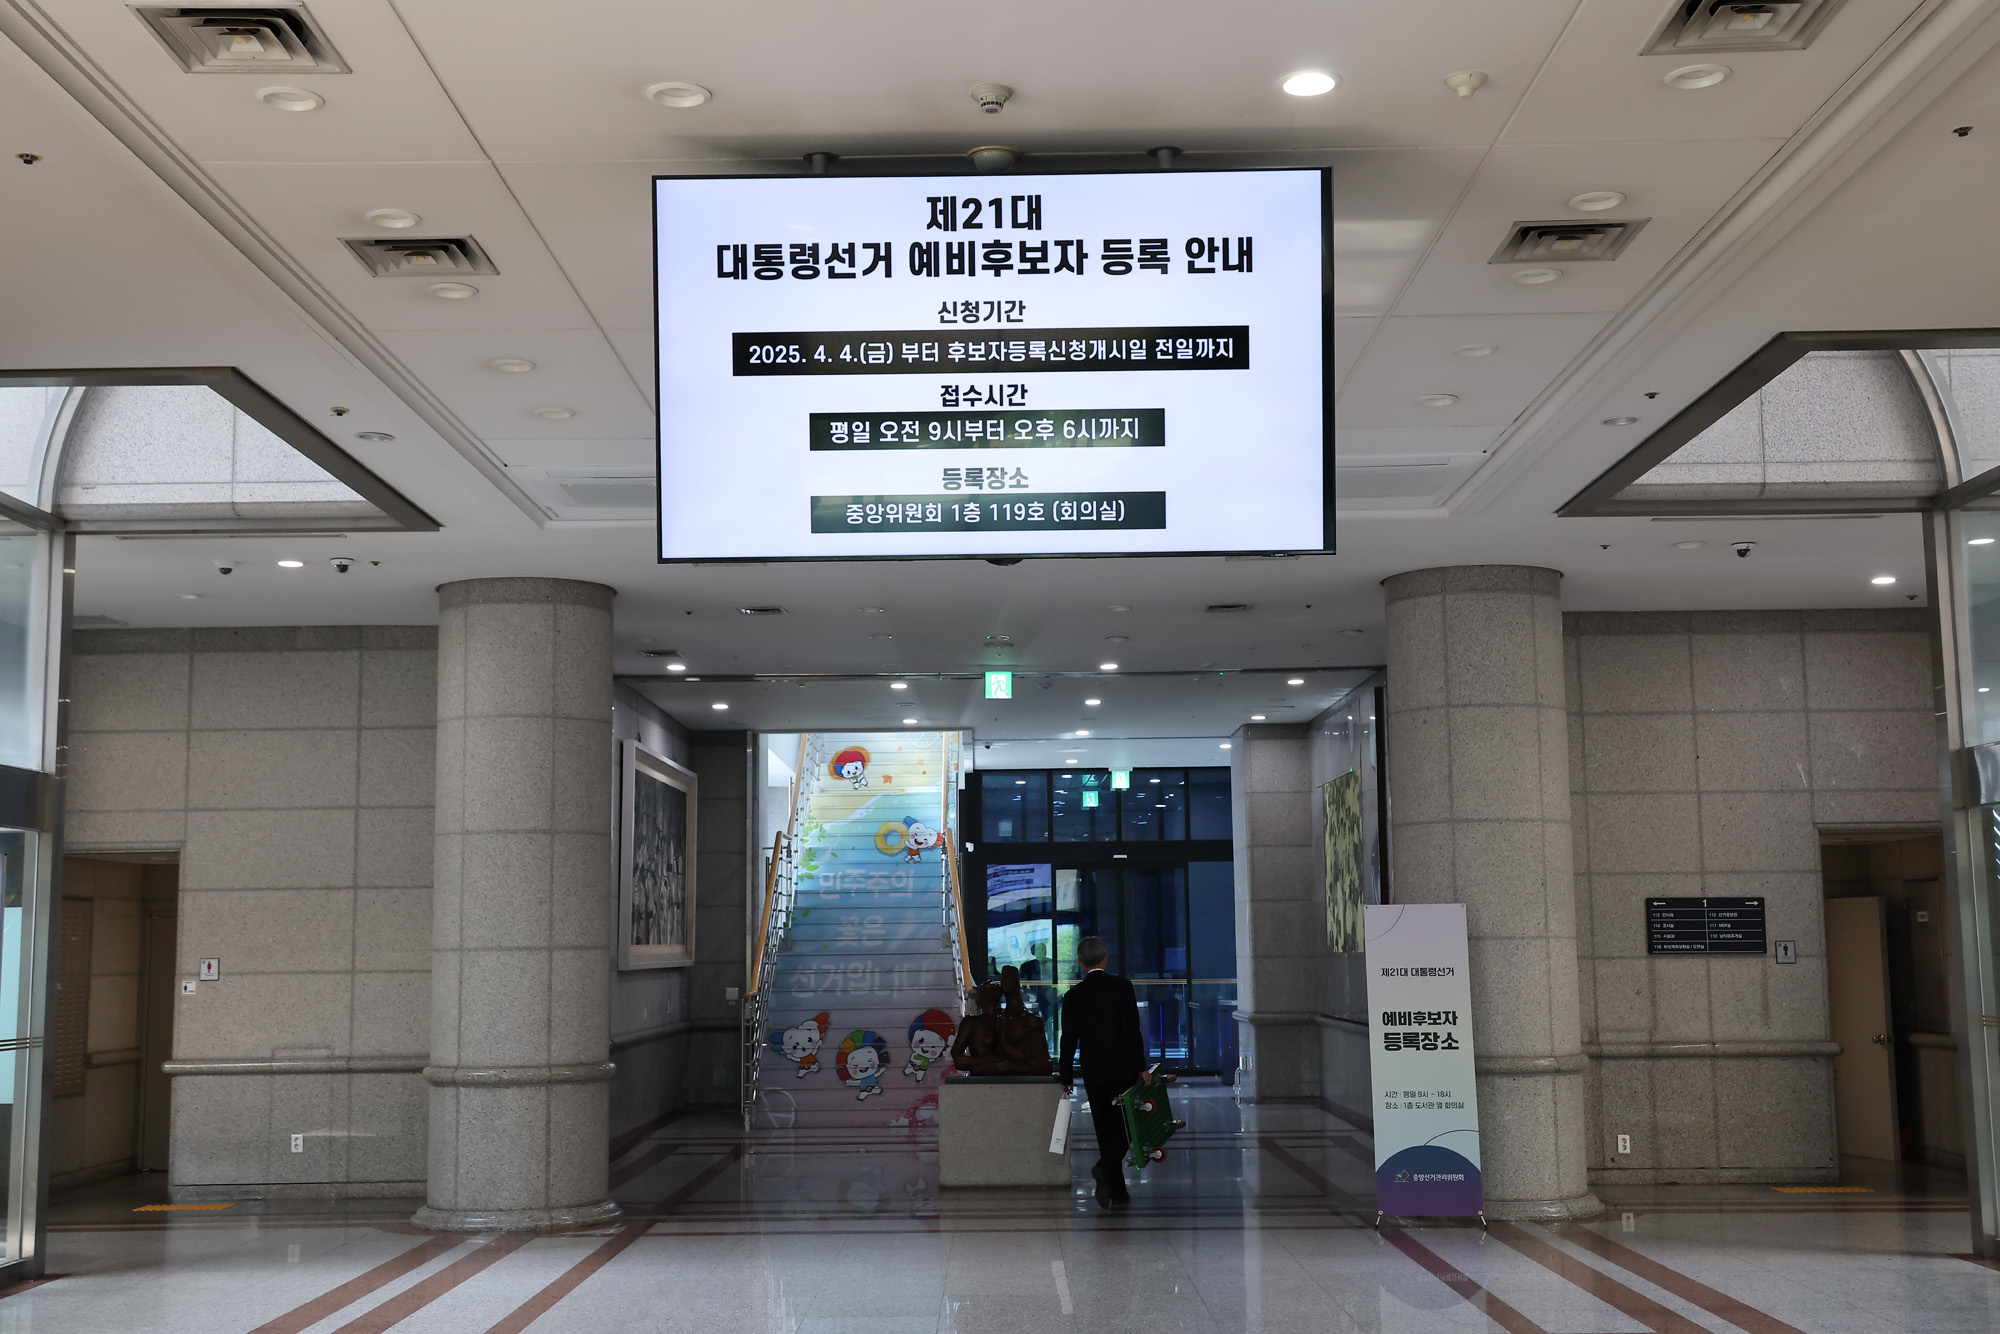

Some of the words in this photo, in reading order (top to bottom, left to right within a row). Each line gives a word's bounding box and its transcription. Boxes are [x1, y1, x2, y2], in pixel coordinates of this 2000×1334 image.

[926, 194, 1042, 232] 제21대
[716, 241, 893, 281] 대통령선거
[908, 238, 1089, 278] 예비후보자
[1100, 238, 1171, 276] 등록
[1184, 236, 1253, 274] 안내
[937, 299, 1027, 324] 신청기간
[901, 341, 939, 364] 부터
[947, 338, 1147, 363] 후보자등록신청개시일
[1155, 337, 1234, 360] 전일까지
[940, 383, 1029, 408] 접수시간
[829, 421, 871, 444] 평일
[879, 421, 920, 445] 오전
[928, 419, 1005, 442] 9시부터
[1012, 419, 1057, 442] 오후
[1062, 417, 1140, 442] 6시까지
[941, 466, 1029, 491] 등록장소
[845, 500, 942, 525] 중앙위원회
[951, 501, 981, 523] 1층
[989, 500, 1045, 521] 119호
[1052, 499, 1125, 523] (회의실)
[819, 869, 915, 900] 민주주의
[836, 915, 886, 947] 꽃은
[789, 961, 931, 999] 선거입니다
[1381, 968, 1409, 978] 제21대
[1410, 967, 1455, 977] 대통령선거
[1382, 1011, 1459, 1027] 예비후보자
[1383, 1032, 1460, 1052] 등록장소
